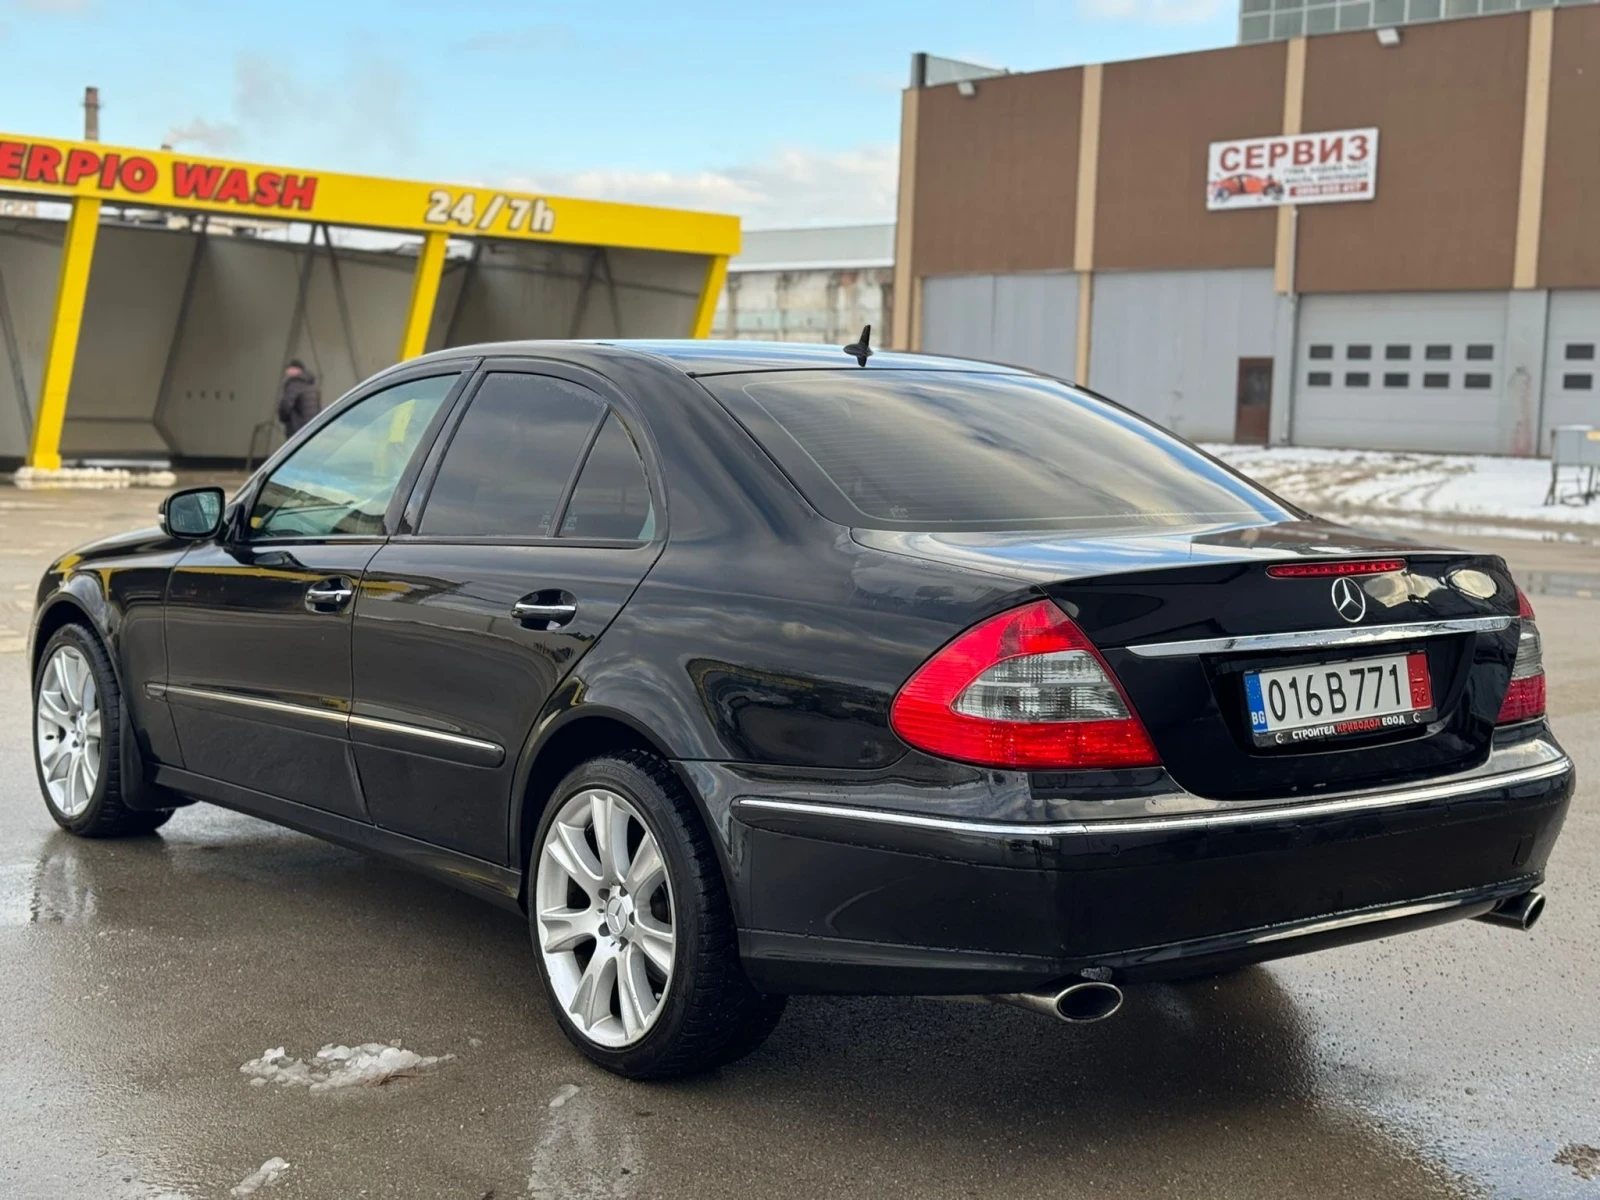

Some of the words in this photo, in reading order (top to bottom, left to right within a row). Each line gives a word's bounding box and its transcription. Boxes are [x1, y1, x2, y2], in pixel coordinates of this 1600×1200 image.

[1219, 135, 1369, 172] СЕРВИЗ
[0, 141, 158, 194] ERPIO
[173, 161, 318, 210] WASH
[424, 188, 555, 233] 24/7h
[1268, 664, 1401, 722] 016B771
[1251, 710, 1266, 726] BG
[1292, 725, 1336, 739] СТРОИТЕЛ
[1381, 714, 1406, 727] ЕООД
